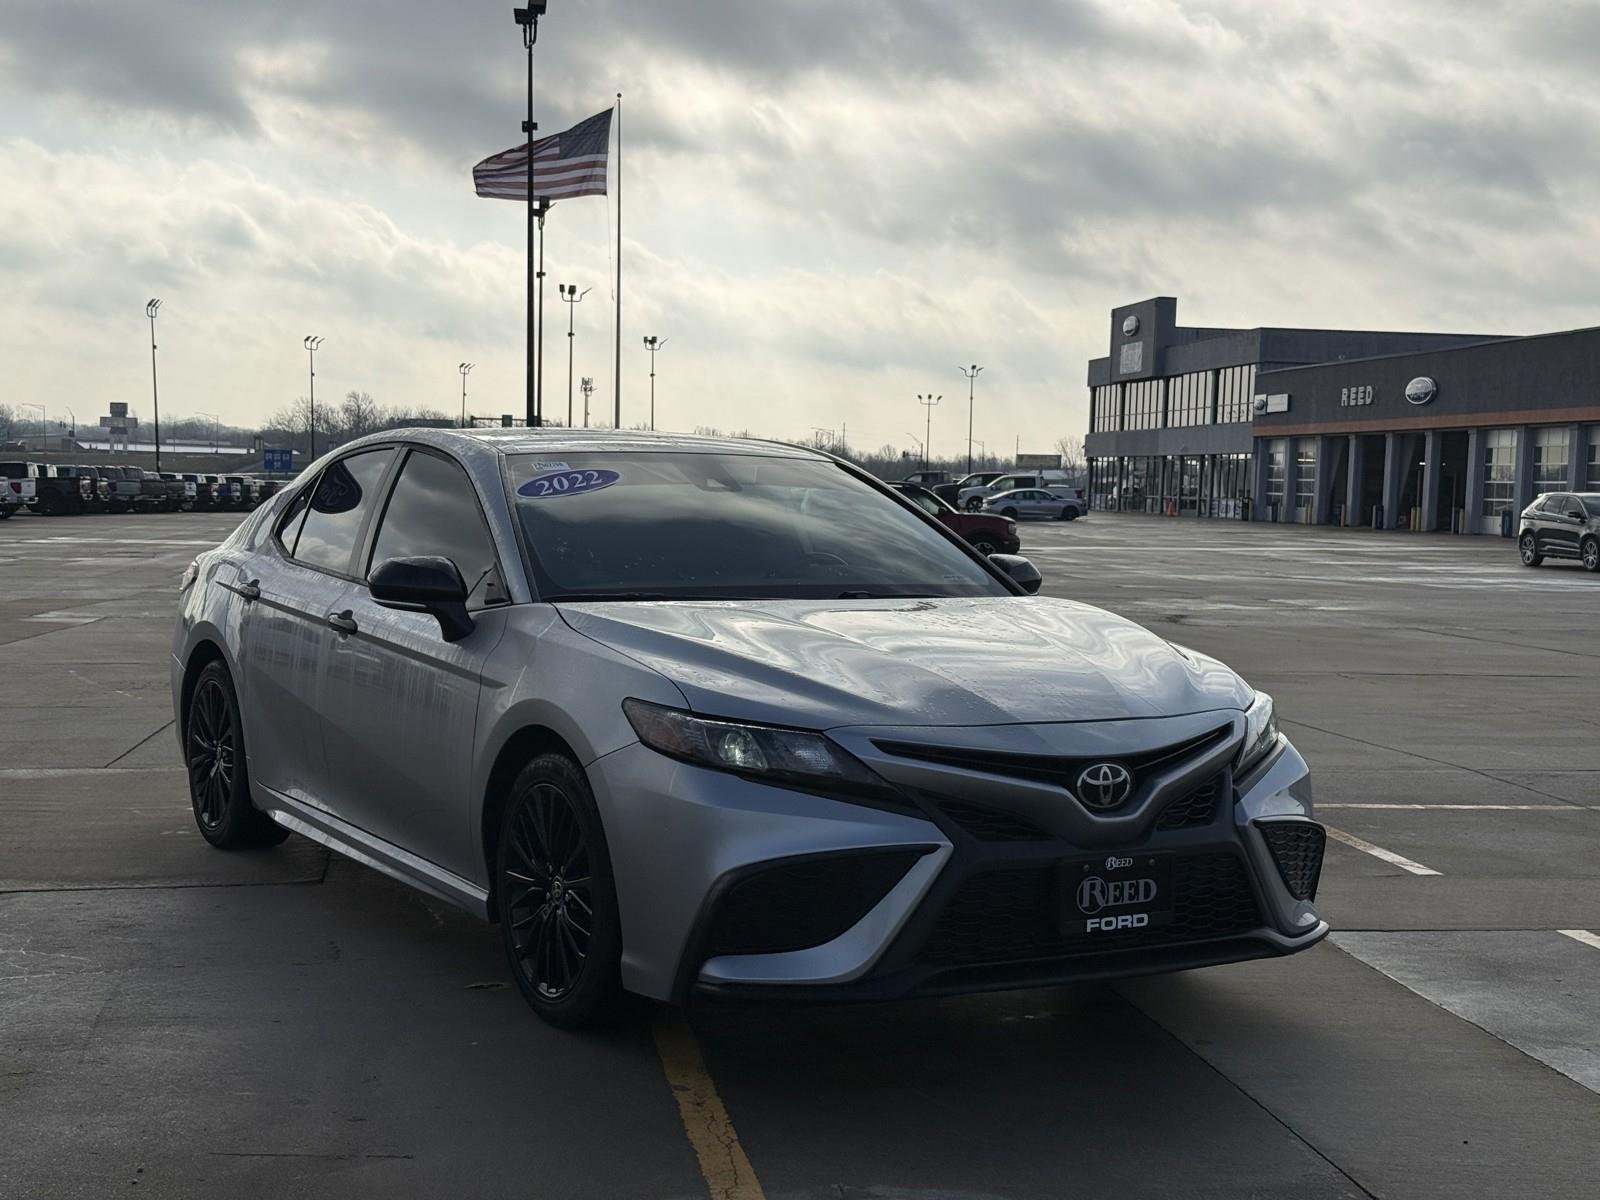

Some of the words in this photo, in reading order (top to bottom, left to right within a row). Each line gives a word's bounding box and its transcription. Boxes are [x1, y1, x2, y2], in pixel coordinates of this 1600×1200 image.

[1341, 385, 1373, 407] REED
[536, 471, 602, 495] 2022
[1105, 856, 1133, 870] REED
[1076, 876, 1157, 914] REED
[1086, 913, 1149, 933] FORD
